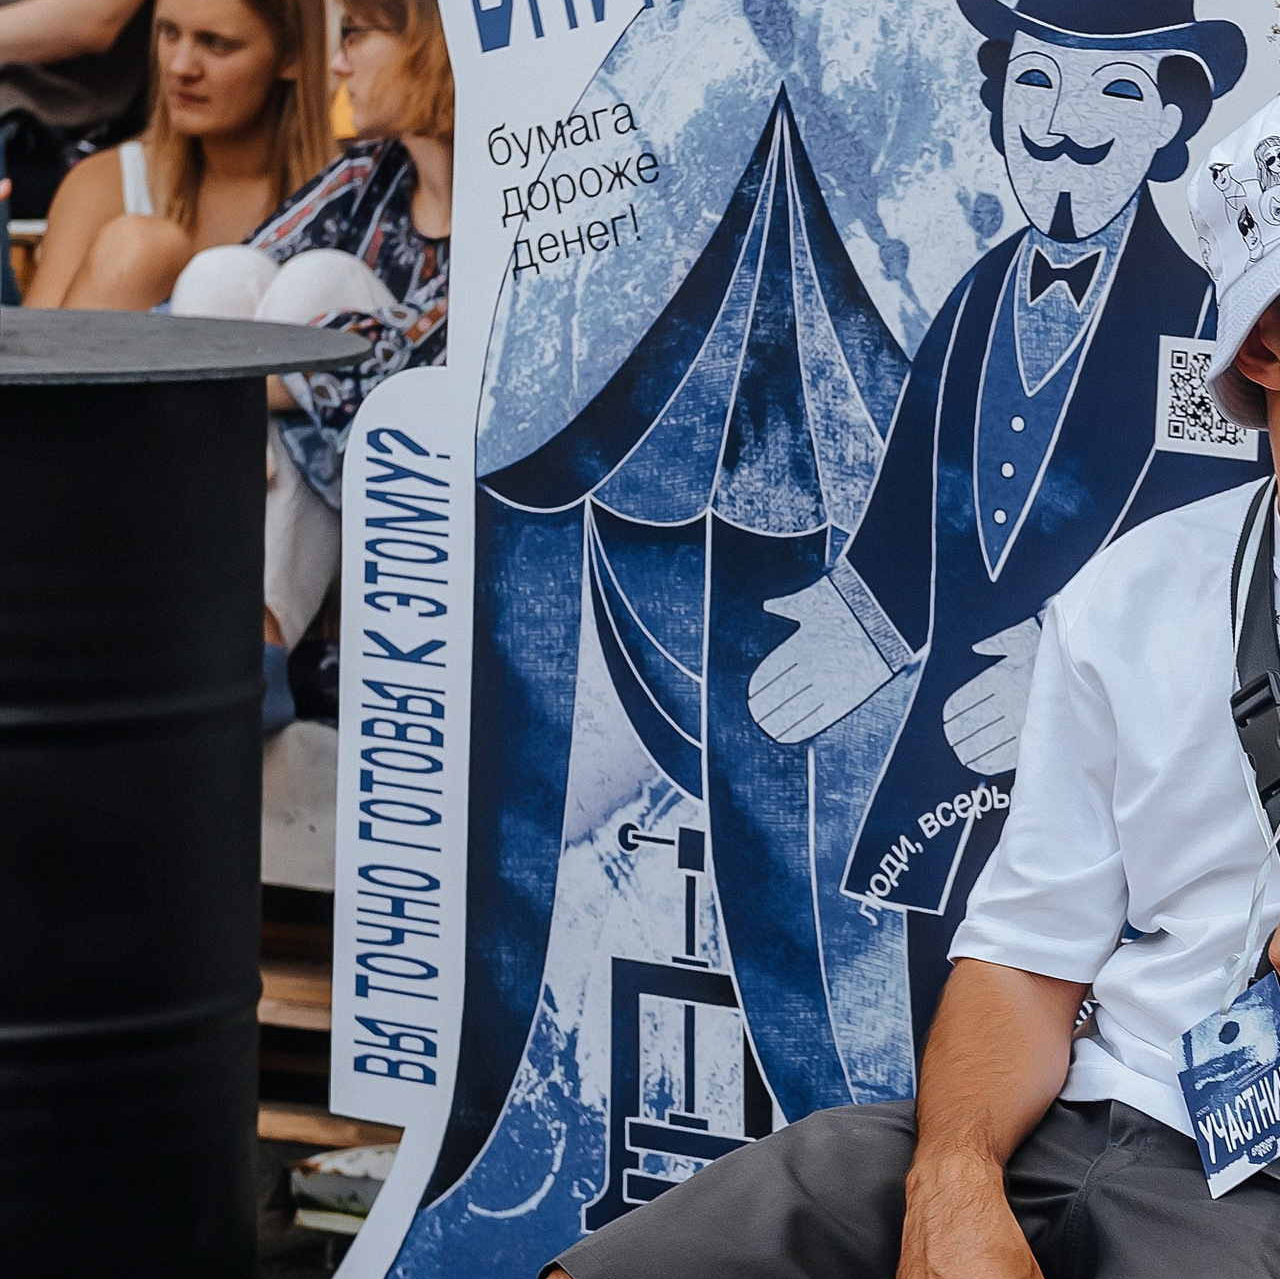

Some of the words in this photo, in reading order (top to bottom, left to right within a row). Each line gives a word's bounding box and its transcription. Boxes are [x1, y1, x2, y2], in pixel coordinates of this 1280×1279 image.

[487, 102, 639, 169] бумага
[501, 152, 660, 229] дороже
[512, 203, 642, 281] денег!
[363, 426, 451, 618] ЭТОМУ?
[362, 629, 447, 667] К
[359, 680, 446, 852] ГОТОВЫ
[858, 834, 924, 927] люди,
[355, 863, 441, 1003] ТОЧНО
[353, 1014, 437, 1087] ВЫ
